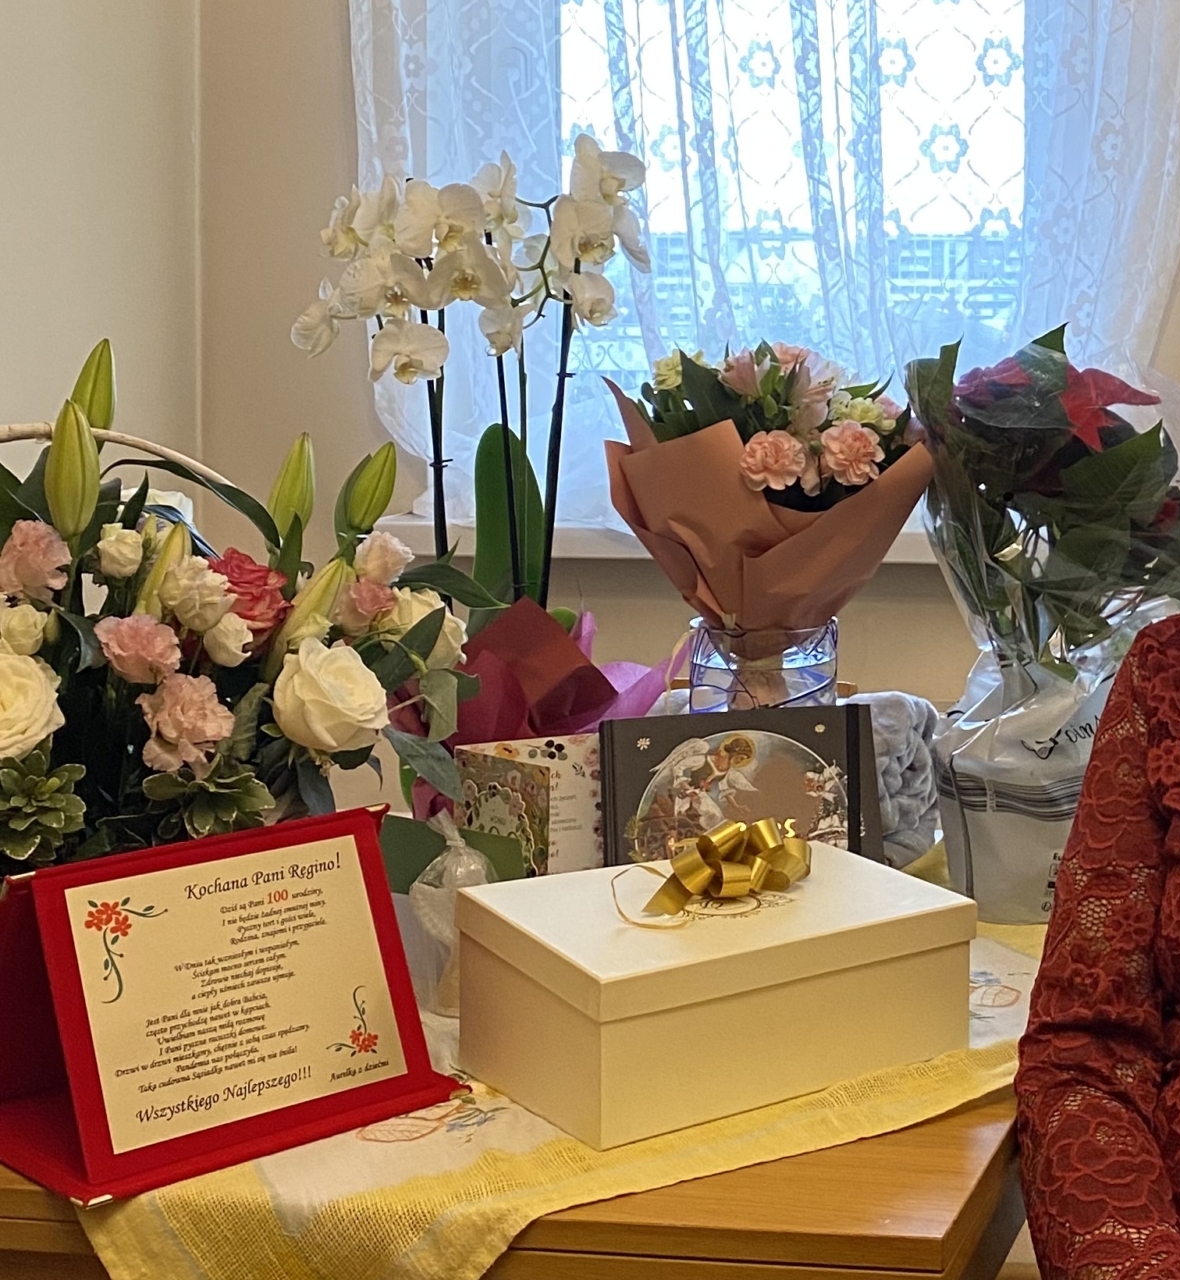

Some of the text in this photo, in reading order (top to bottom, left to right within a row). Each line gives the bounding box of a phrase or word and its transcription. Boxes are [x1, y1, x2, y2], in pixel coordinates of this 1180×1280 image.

[184, 852, 340, 900] Kochana Pani Regino!
[248, 900, 265, 908] Pani
[267, 889, 288, 904] 100
[161, 1014, 178, 1023] Pani
[165, 1044, 182, 1054] Pani
[136, 1065, 311, 1123] Wszystkiego Najlepszego!!!
